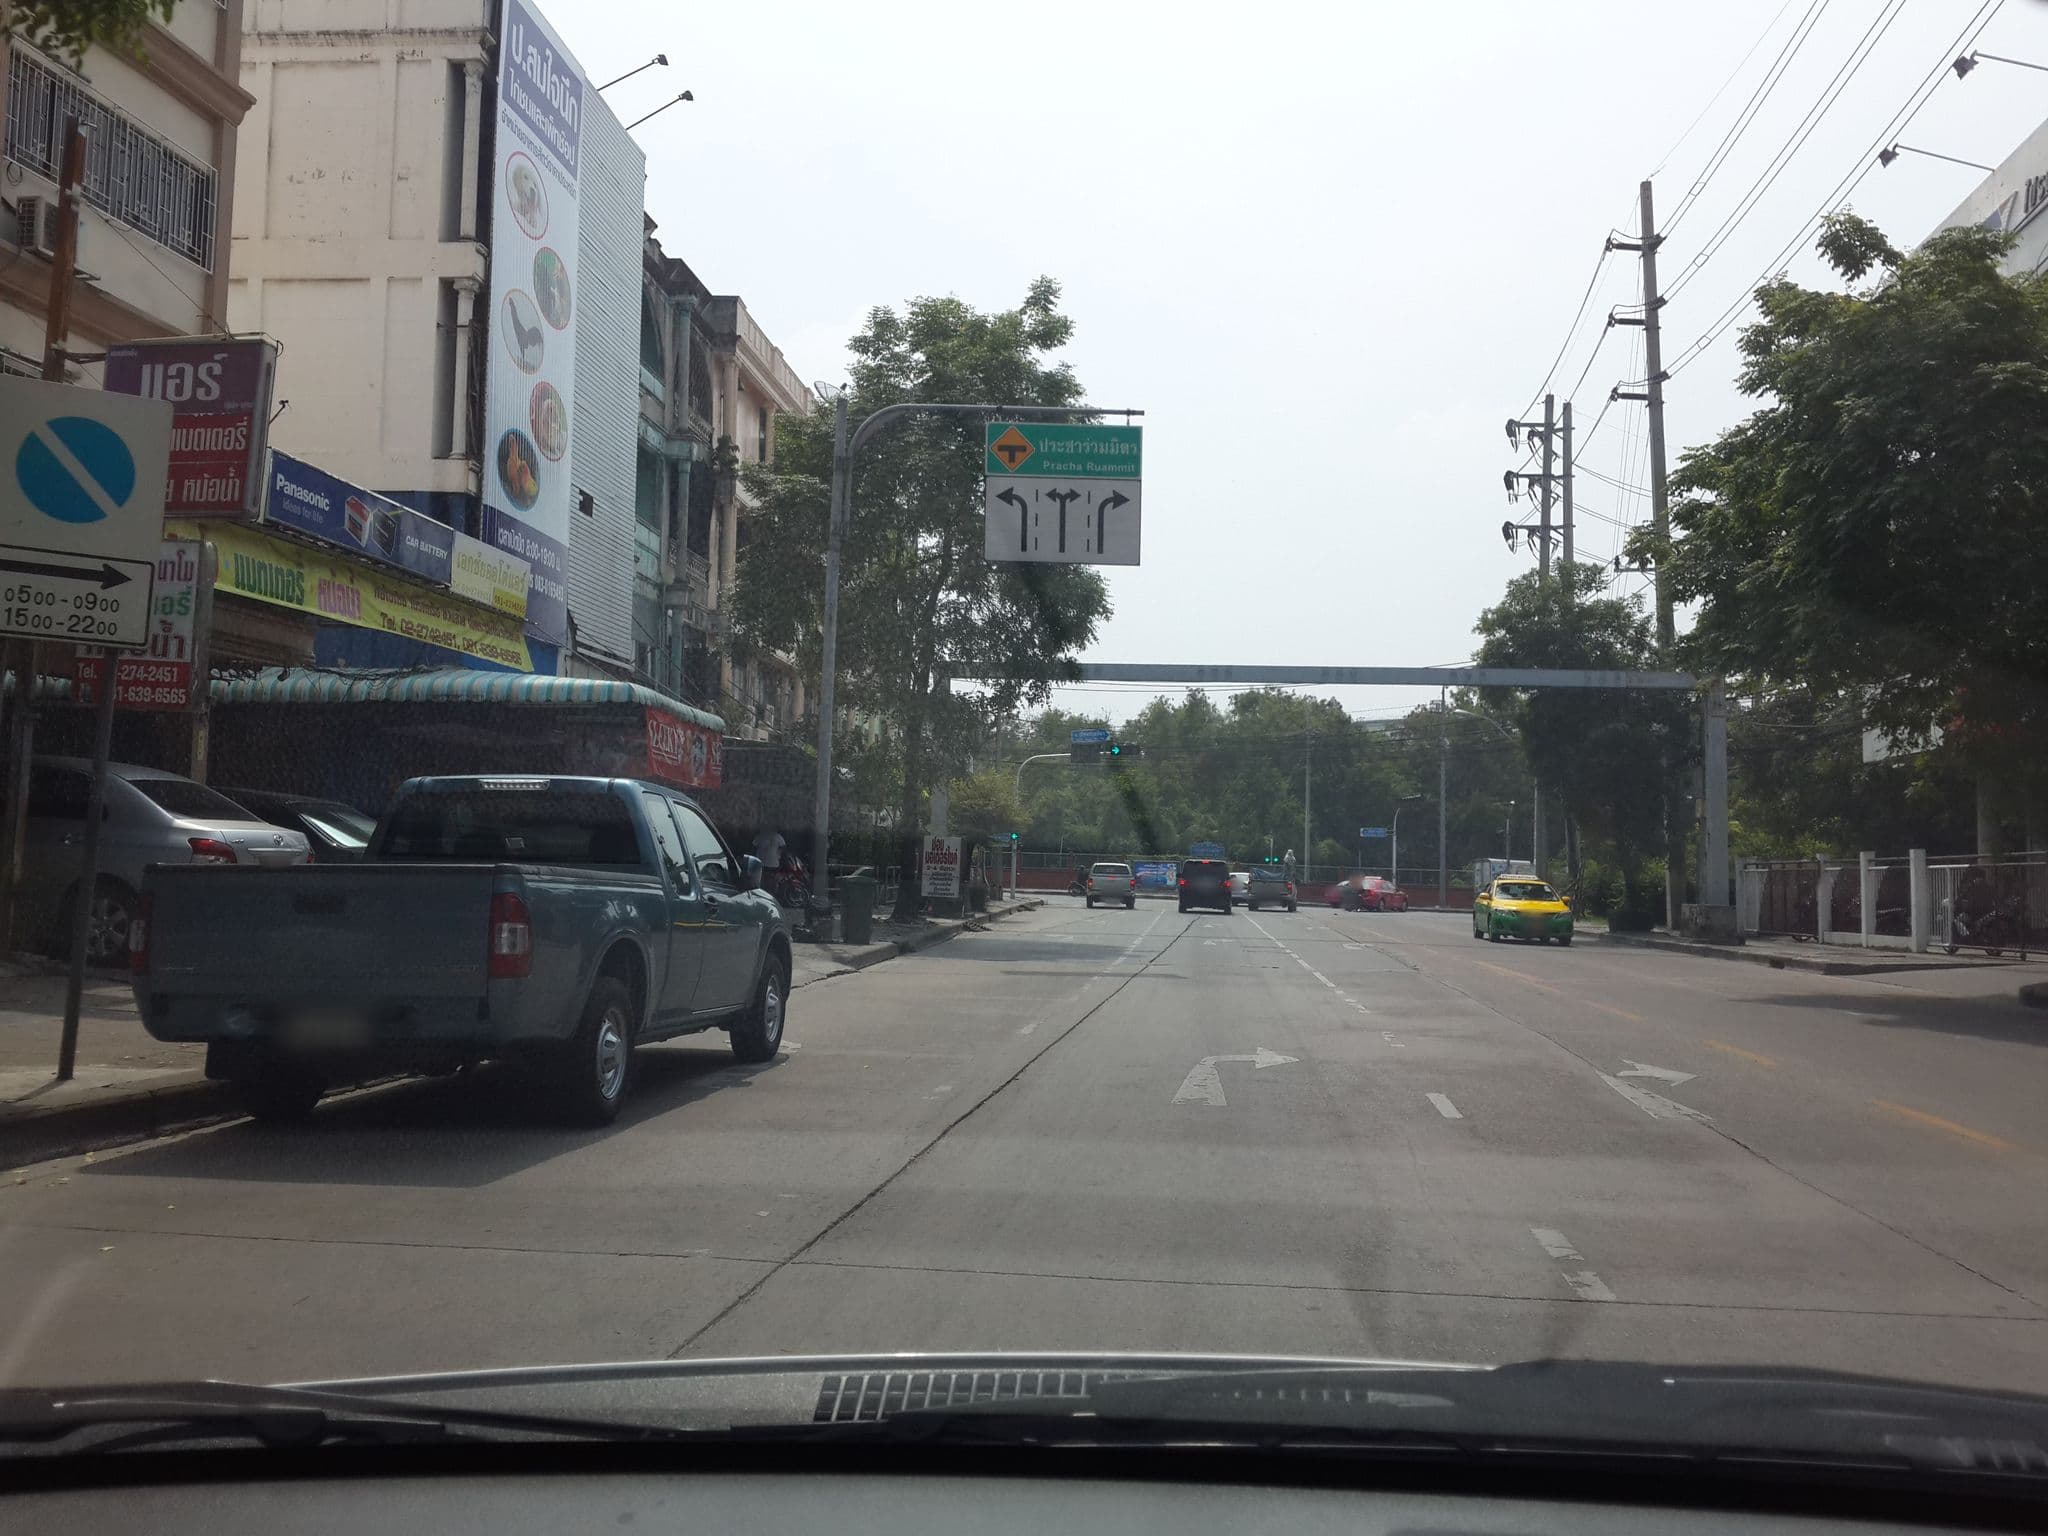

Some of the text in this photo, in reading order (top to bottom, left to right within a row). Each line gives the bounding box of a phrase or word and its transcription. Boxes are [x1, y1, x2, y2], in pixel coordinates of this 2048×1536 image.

[141, 353, 226, 401] แอร์
[171, 417, 248, 451] แบตเตอรี่
[1039, 437, 1138, 456] ประชาร่วมมิตร
[1043, 460, 1136, 473] Pracha Ruammit
[183, 467, 240, 503] หม้อน้ำ
[276, 472, 330, 512] Panasonic
[405, 535, 448, 560] CAR BATTERY
[77, 663, 178, 683] Tel. -274-2451
[113, 685, 187, 705] 1-639-6565
